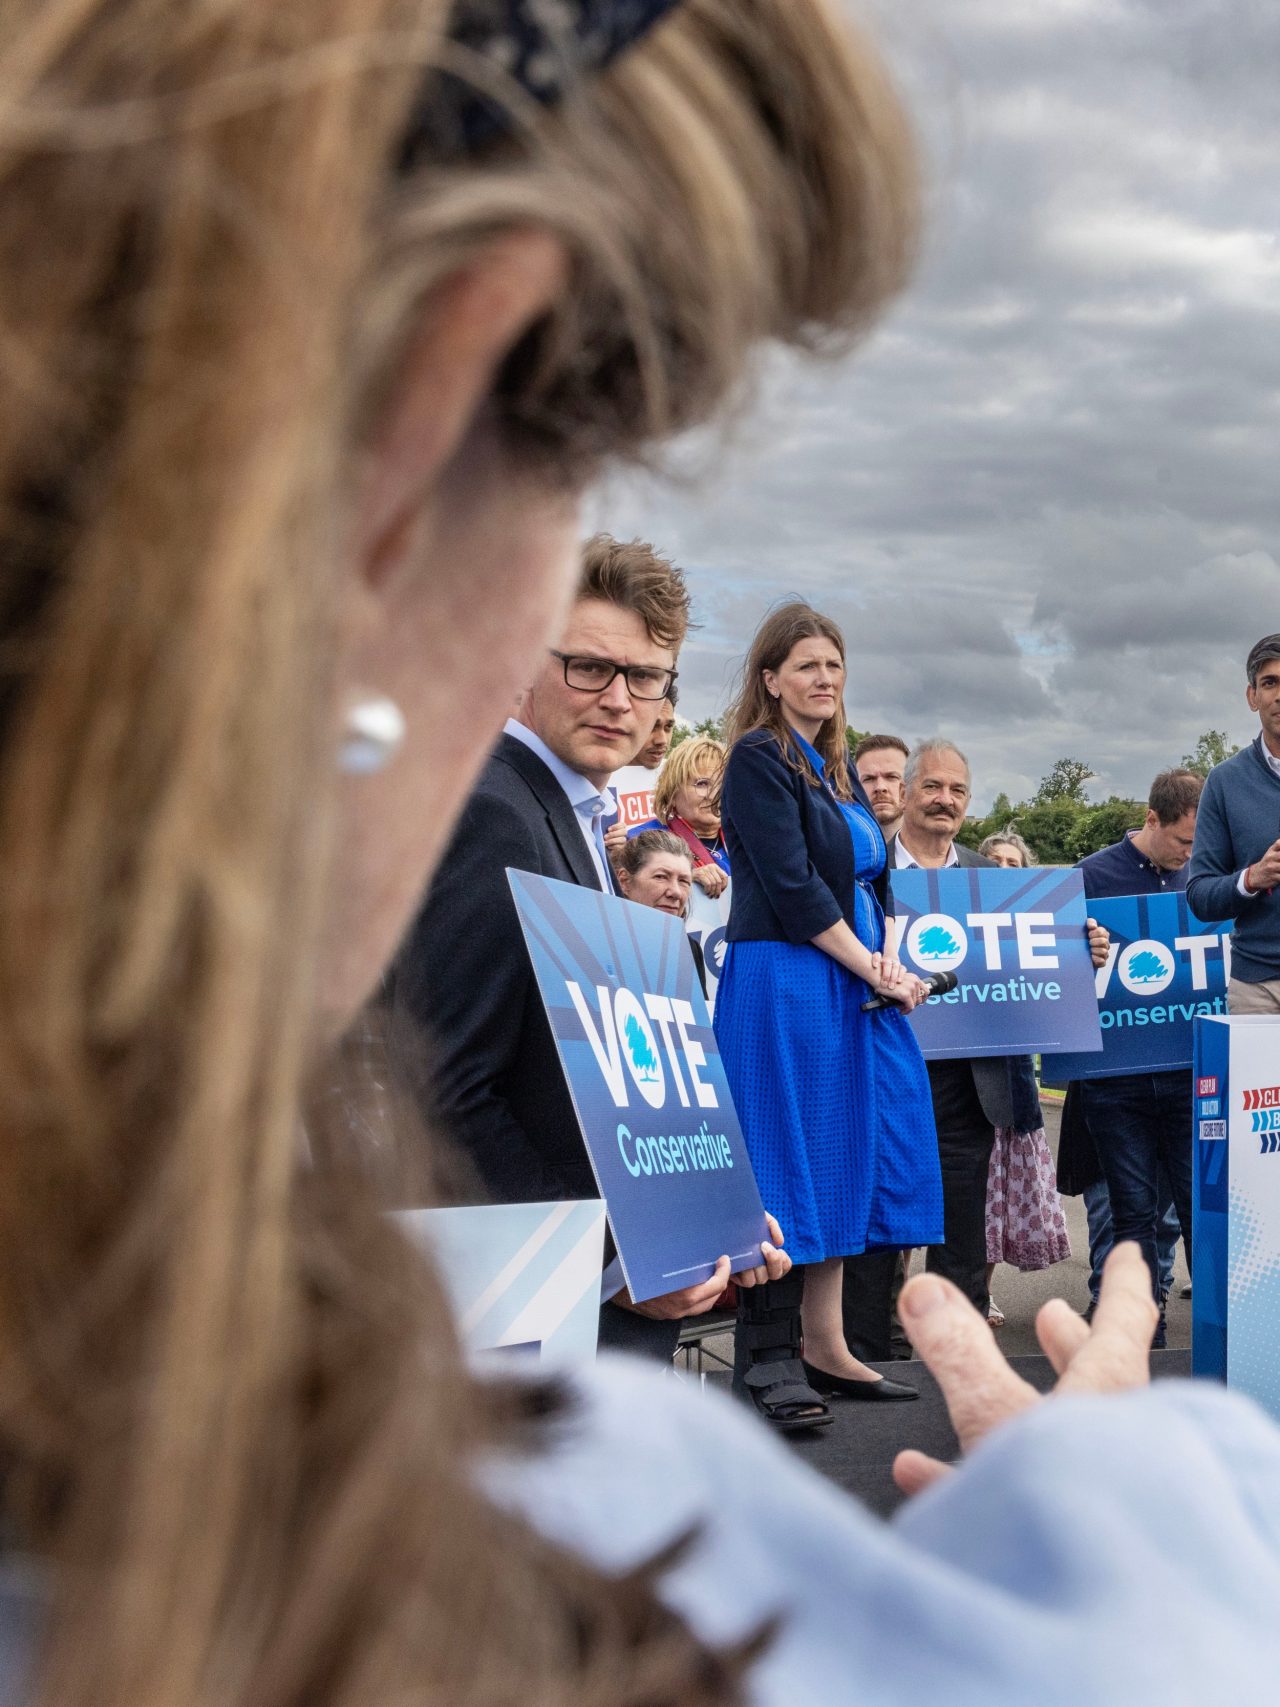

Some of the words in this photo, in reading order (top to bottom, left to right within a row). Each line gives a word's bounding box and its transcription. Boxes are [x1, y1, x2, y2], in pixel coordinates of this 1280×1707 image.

[626, 793, 658, 821] CLE
[894, 912, 1060, 973] OTE
[925, 975, 1062, 1005] servative
[1098, 992, 1231, 1029] onservati
[565, 980, 720, 1110] VOTE
[616, 1119, 734, 1178] Conservative
